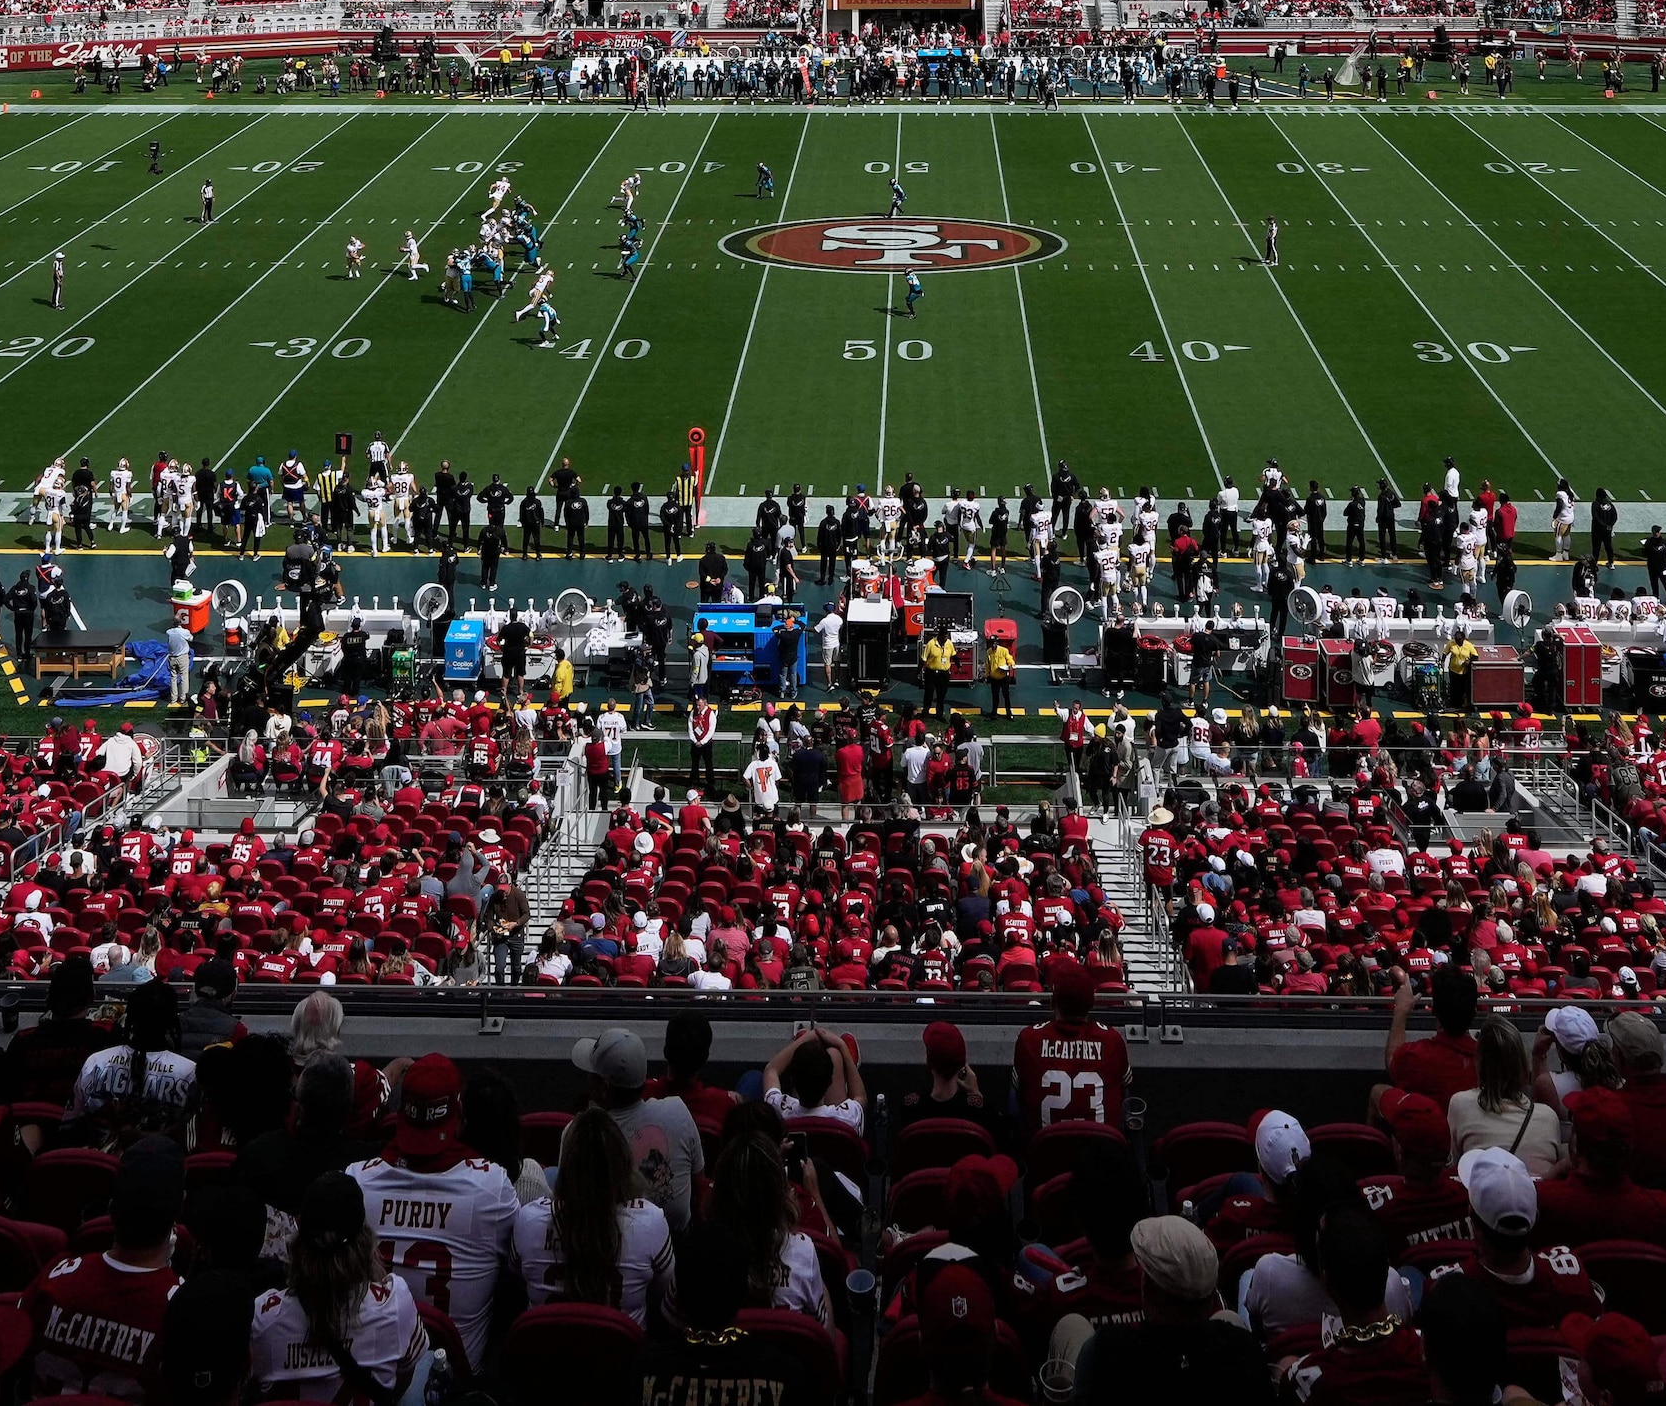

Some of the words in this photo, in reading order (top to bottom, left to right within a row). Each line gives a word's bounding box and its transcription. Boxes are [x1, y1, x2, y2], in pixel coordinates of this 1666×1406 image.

[1389, 105, 1534, 113] CANCER
[274, 337, 372, 359] 30
[558, 339, 651, 360] 40
[843, 340, 933, 361] 50
[1128, 341, 1220, 363] 40
[1412, 341, 1511, 363] 30
[114, 477, 122, 489] 9
[394, 481, 408, 494] 88
[883, 505, 897, 517] 26
[1148, 844, 1171, 867] 23
[1040, 1039, 1103, 1062] McCAFFREY
[1040, 1069, 1106, 1129] 23
[378, 1199, 453, 1230] PURDY
[44, 1304, 156, 1366] McCAFFREY
[641, 1375, 784, 1406] McCAFFREY
